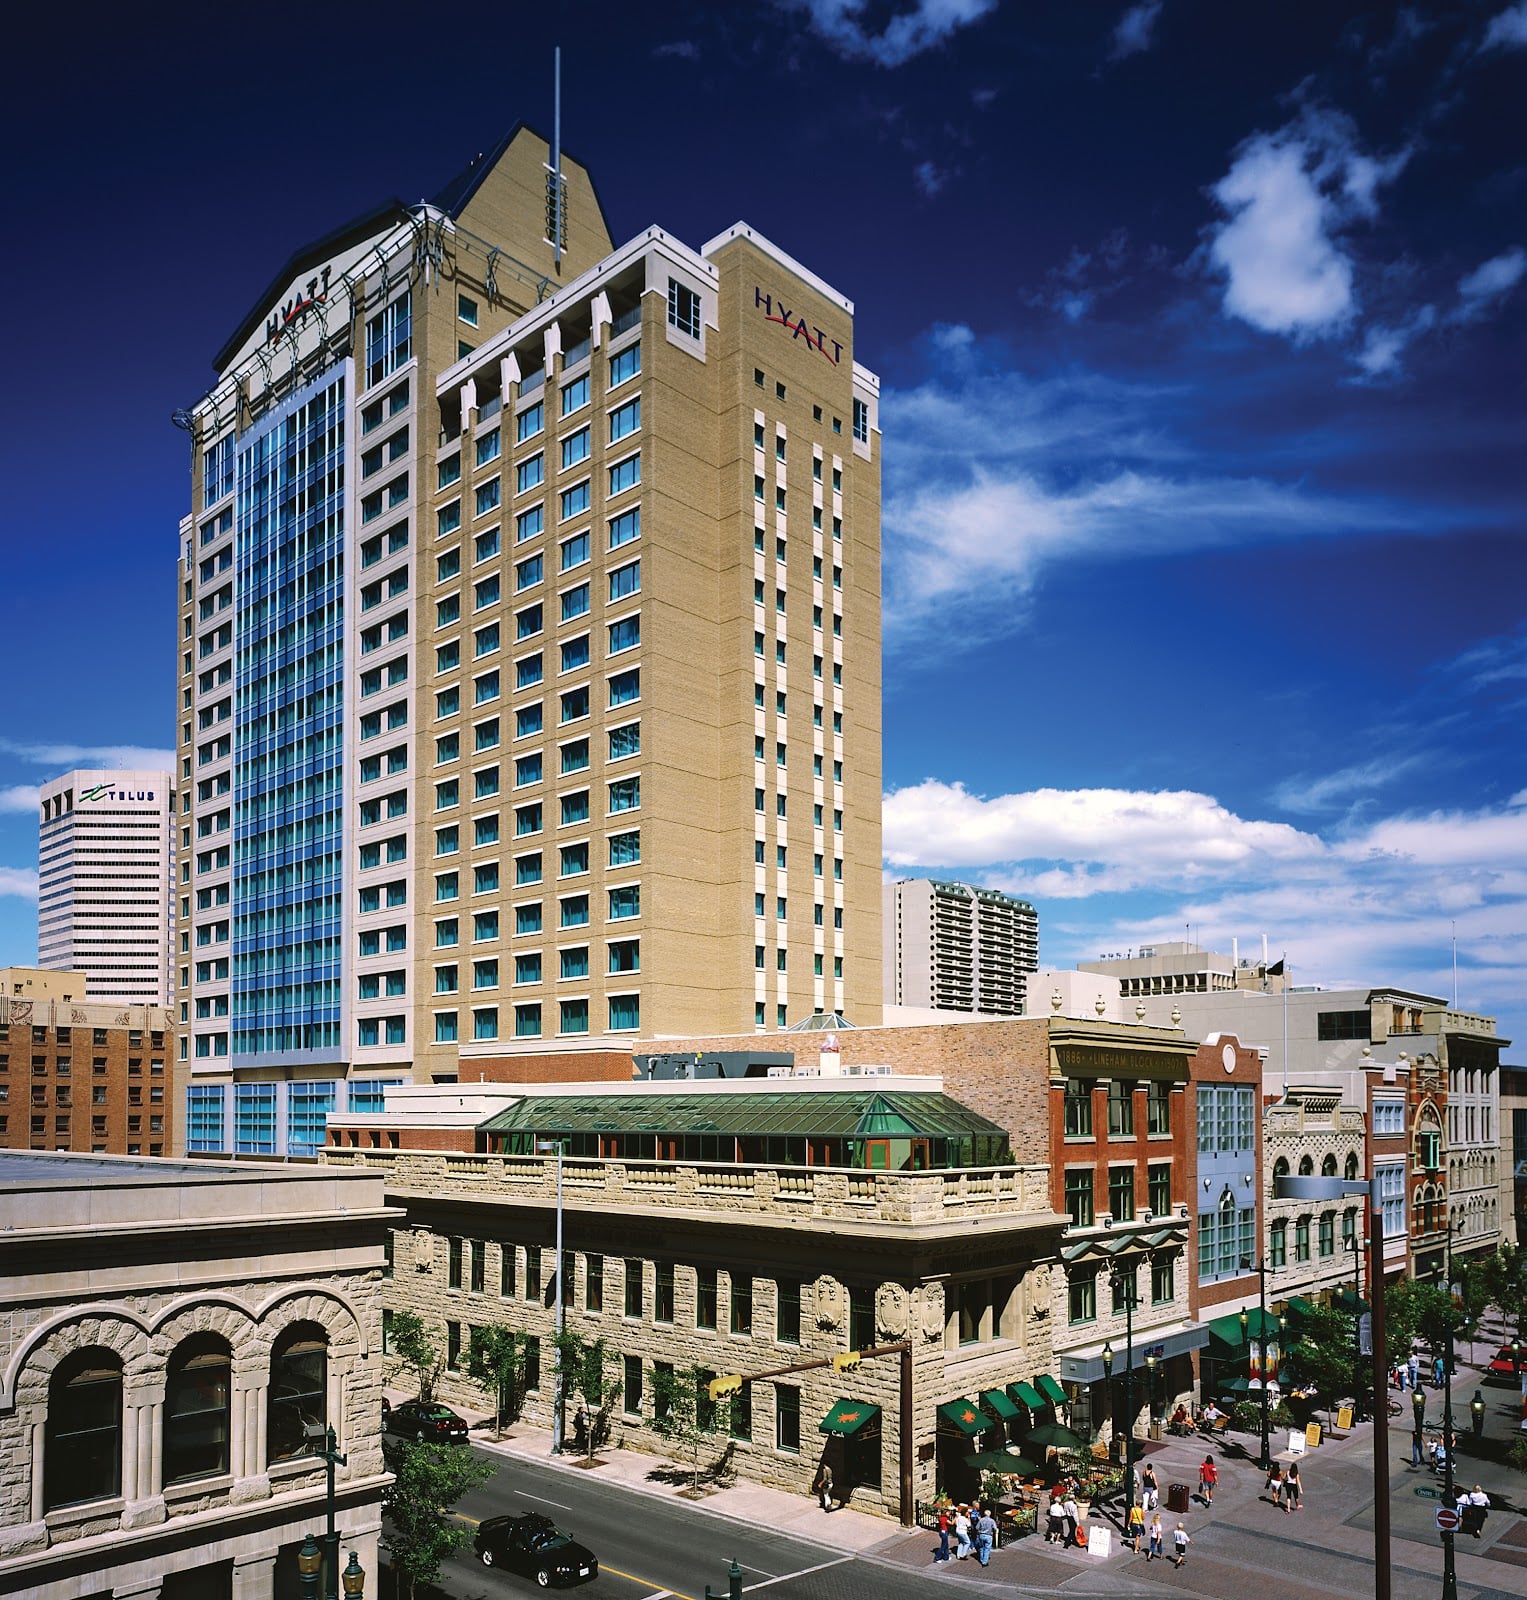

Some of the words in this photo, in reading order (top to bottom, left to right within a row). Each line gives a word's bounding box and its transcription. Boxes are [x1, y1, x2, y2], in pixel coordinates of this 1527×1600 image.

[266, 265, 331, 348] HYATT
[755, 286, 844, 363] HYATT
[109, 791, 155, 801] TELUS
[1062, 1050, 1081, 1064] 1886
